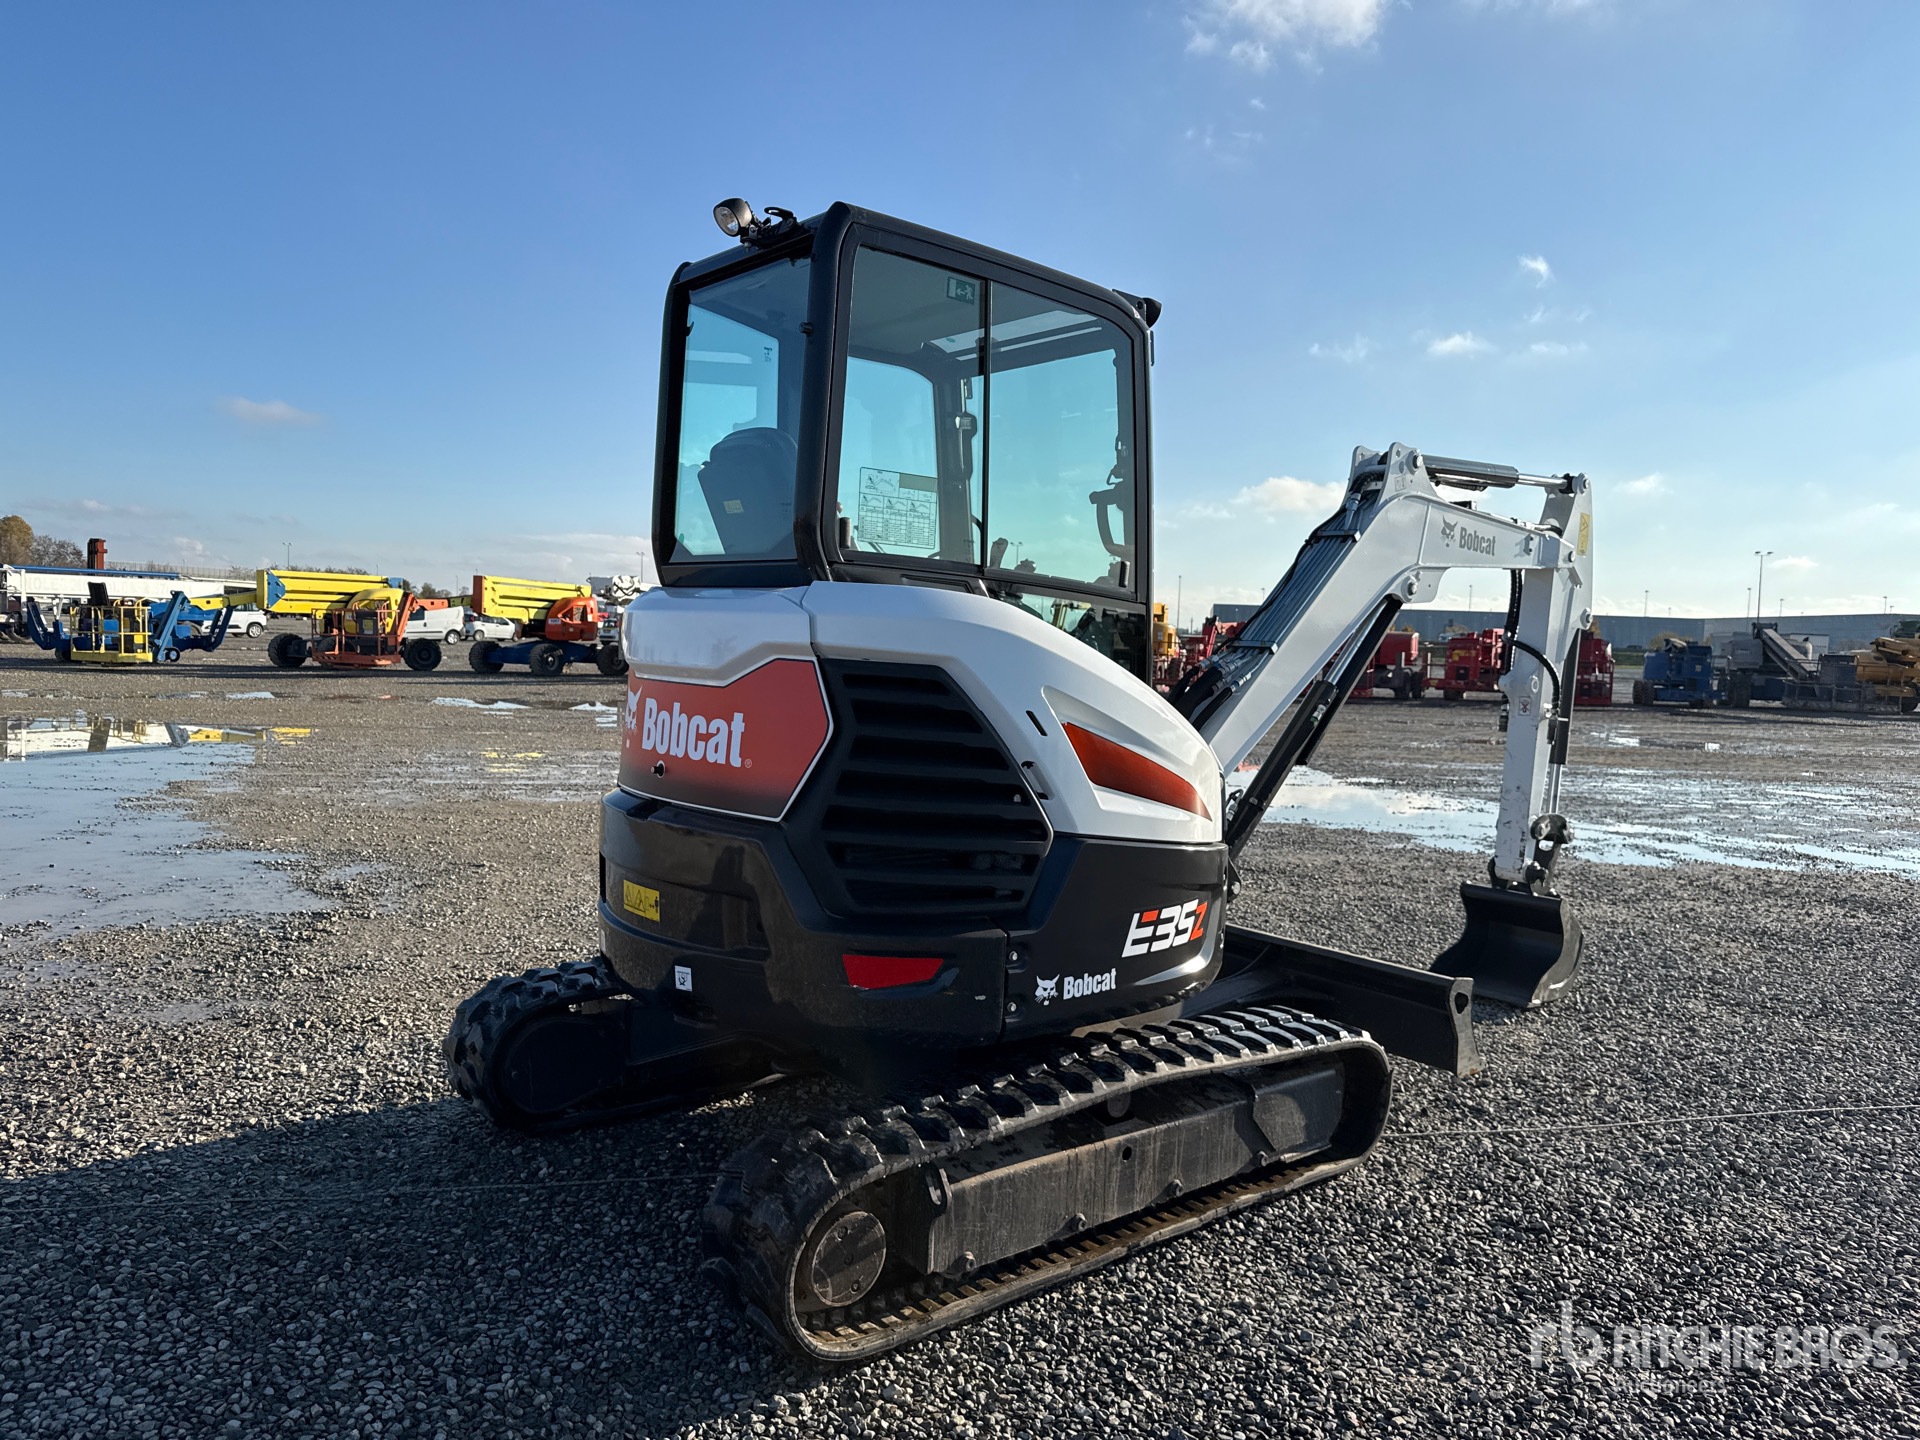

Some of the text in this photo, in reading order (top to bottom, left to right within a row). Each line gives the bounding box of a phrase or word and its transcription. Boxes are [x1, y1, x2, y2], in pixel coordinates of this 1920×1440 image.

[1458, 526, 1496, 557] Bobcat
[641, 697, 745, 768] Bobcat
[1063, 967, 1117, 1000] Bobcat
